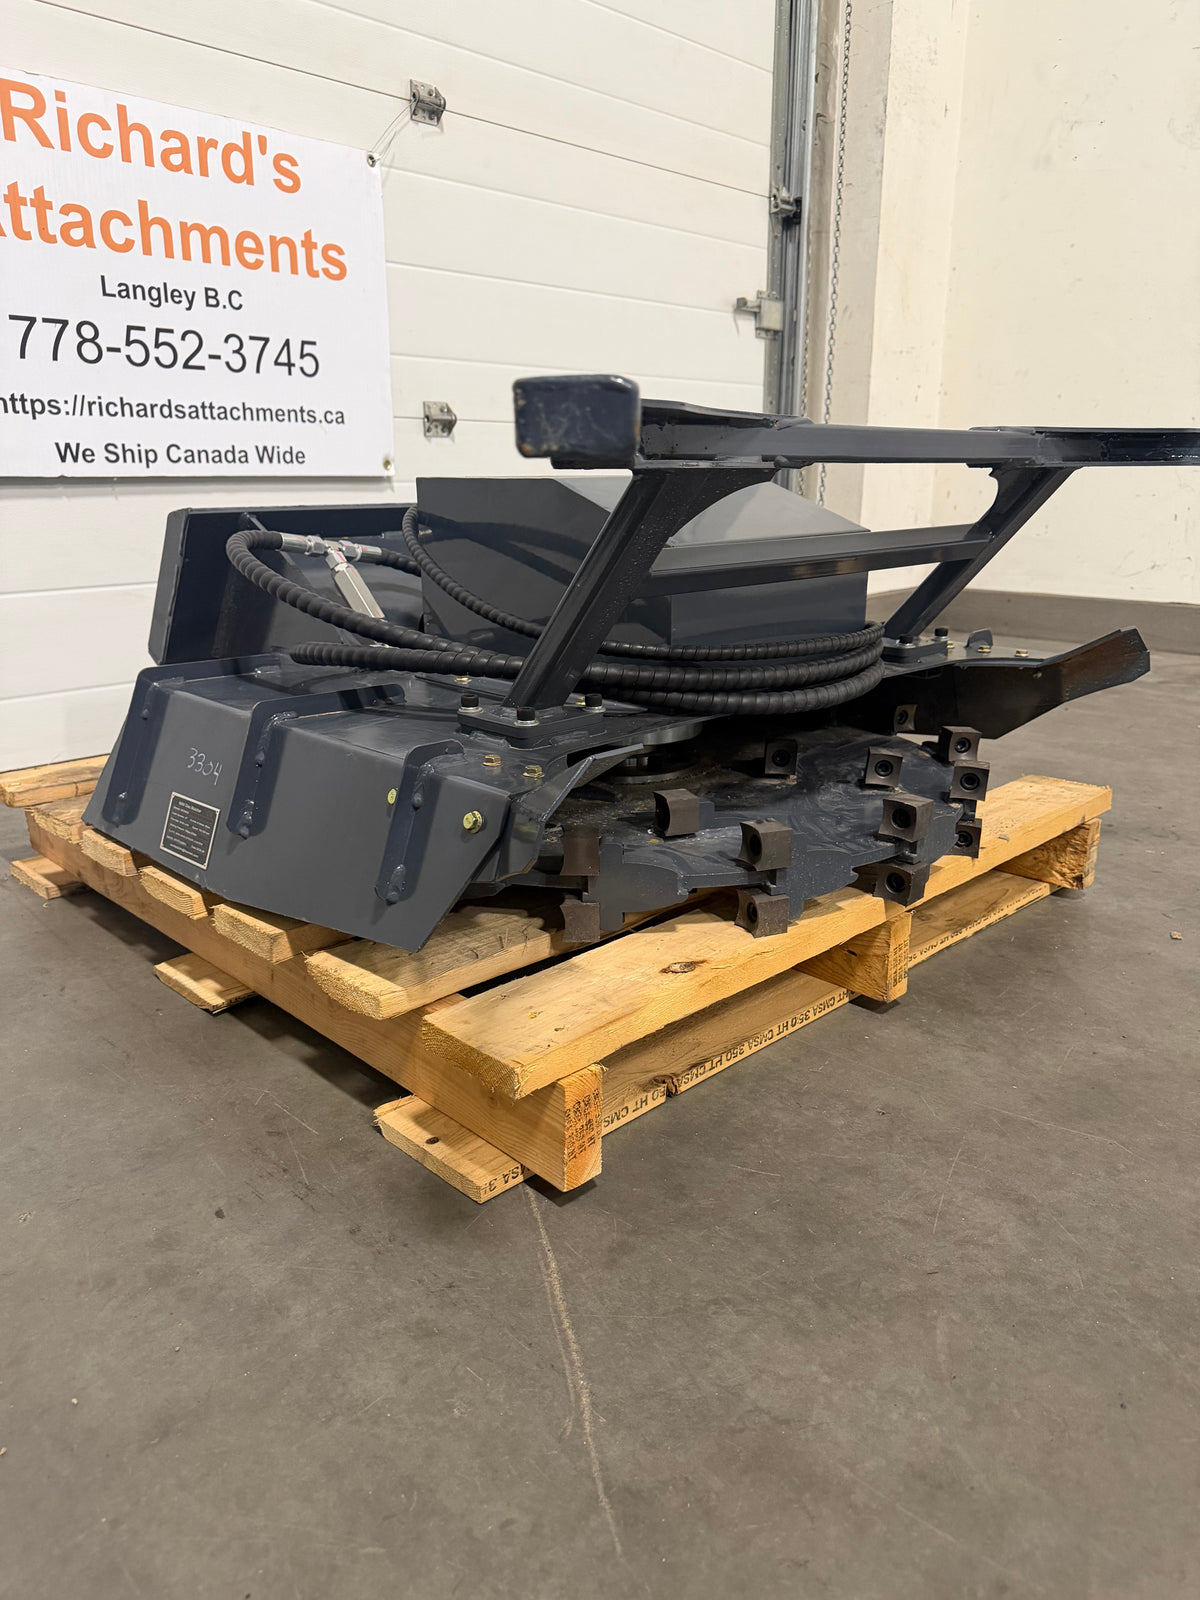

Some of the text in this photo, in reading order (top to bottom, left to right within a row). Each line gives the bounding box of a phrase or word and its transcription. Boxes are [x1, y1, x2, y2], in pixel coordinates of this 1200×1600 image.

[0, 78, 302, 194] Richard's
[0, 181, 347, 281] ttachments
[100, 275, 243, 311] Langley B.C
[8, 314, 320, 378] 778-552-3745
[55, 442, 306, 469] We Ship Canada Wide
[187, 747, 223, 786] 3304
[747, 1029, 774, 1050] CMSA
[776, 1020, 789, 1036] HT
[632, 1094, 648, 1113] HT
[651, 1085, 667, 1102] 50
[603, 1105, 629, 1128] CMS
[502, 1163, 531, 1184] SA
